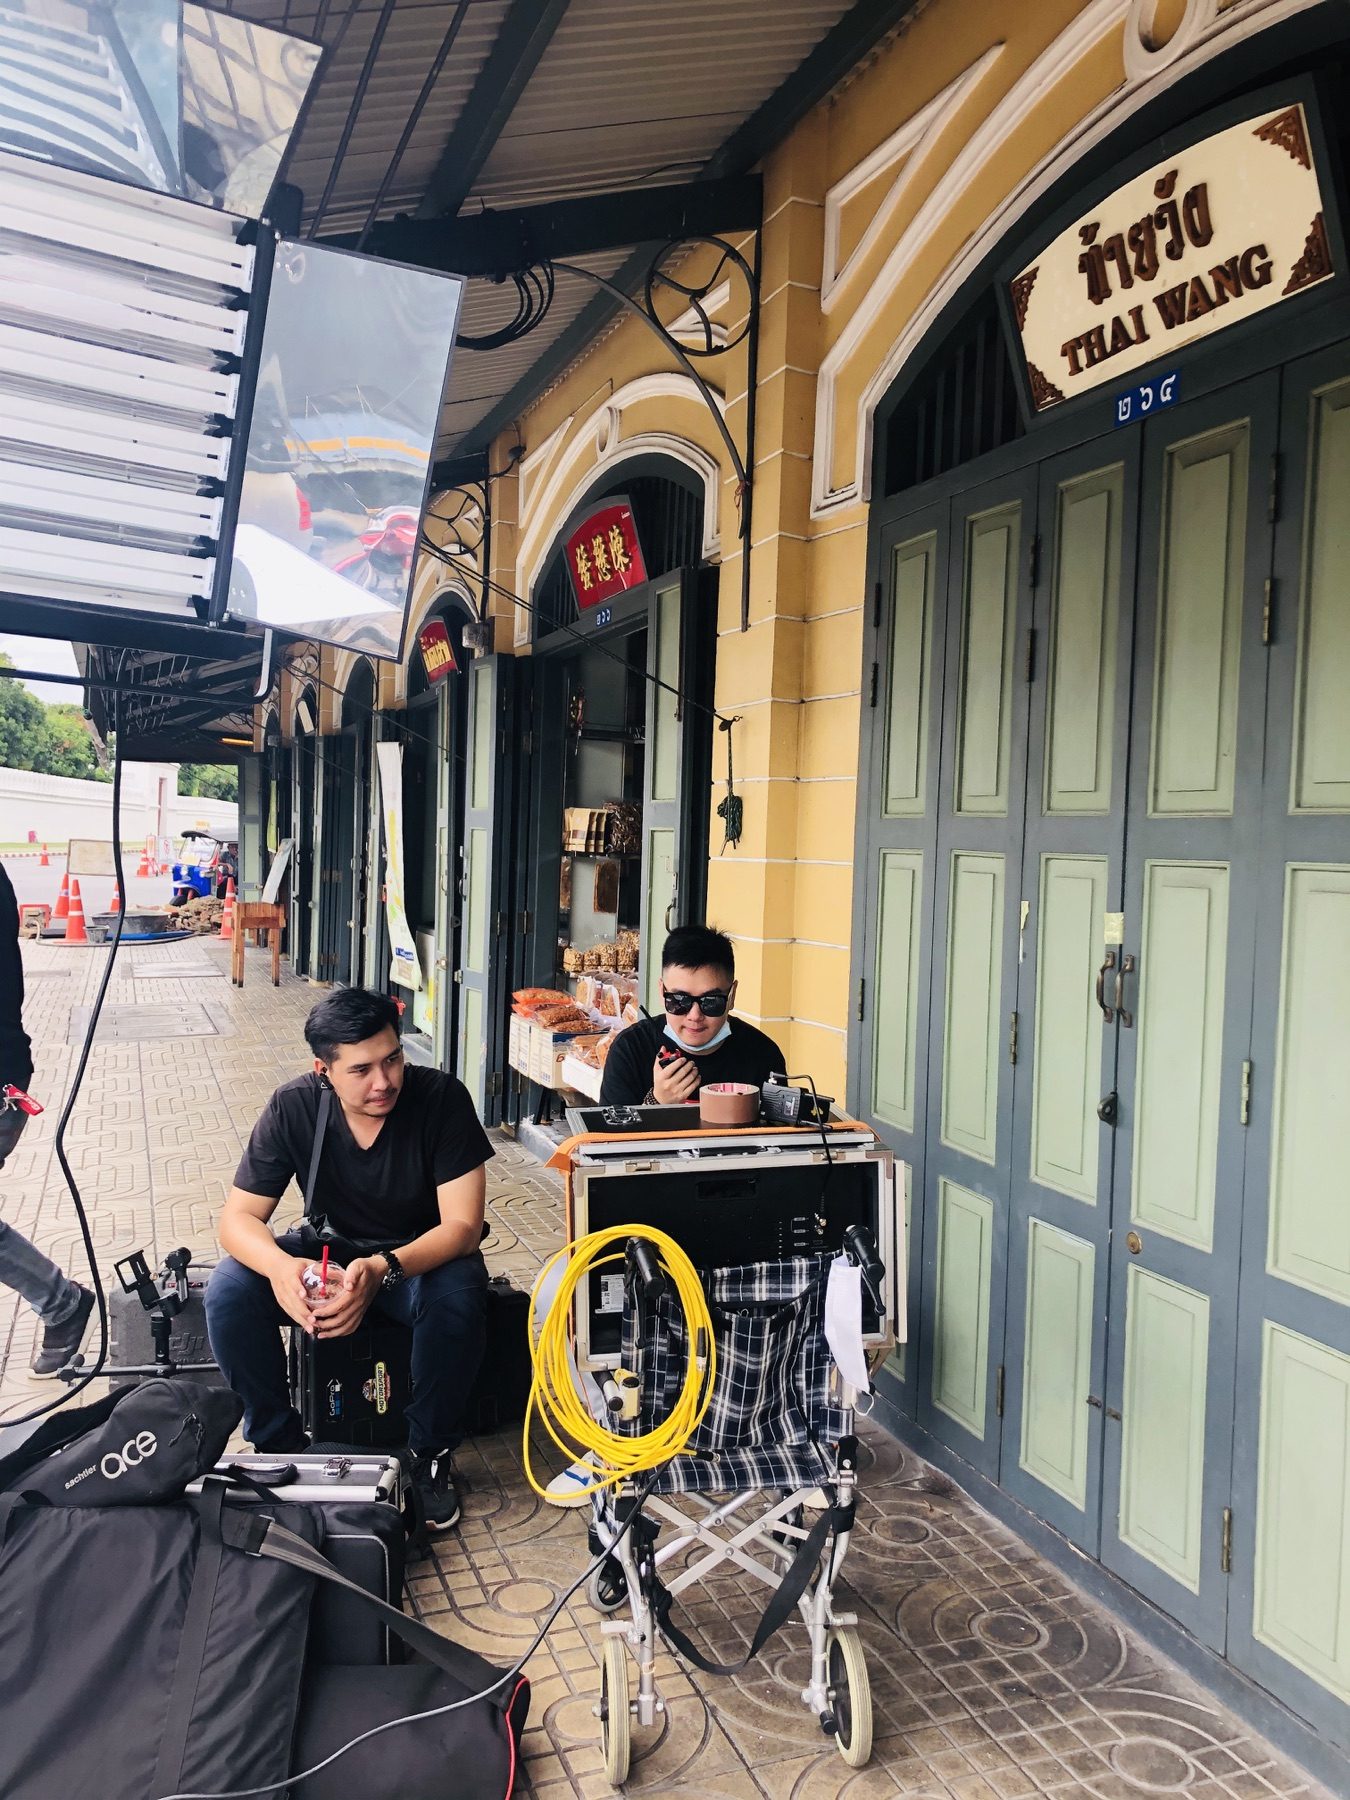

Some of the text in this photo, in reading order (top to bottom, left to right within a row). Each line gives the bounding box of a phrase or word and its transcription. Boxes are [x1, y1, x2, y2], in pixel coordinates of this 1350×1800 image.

[1078, 169, 1214, 305] ท้ายวัง
[1061, 244, 1273, 376] THAI WANG
[377, 1363, 385, 1412] MOTORSPORT
[64, 1430, 158, 1490] sachtler ace
